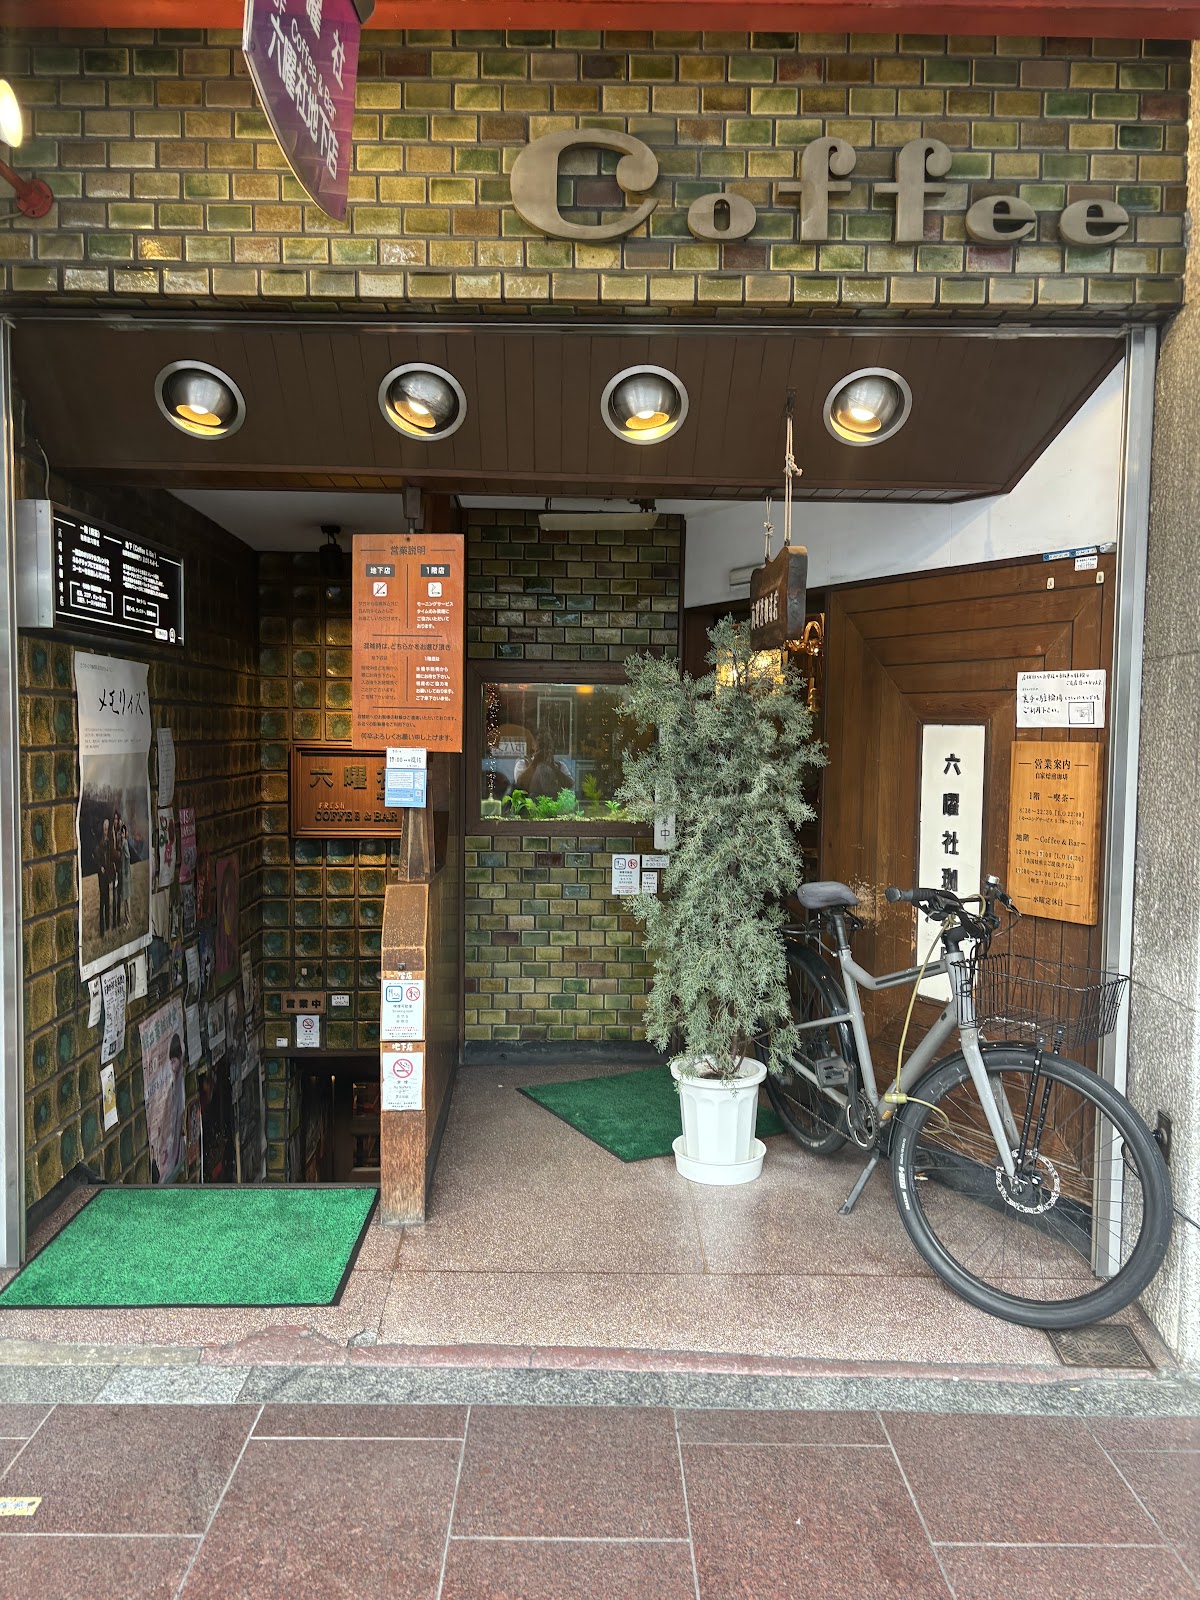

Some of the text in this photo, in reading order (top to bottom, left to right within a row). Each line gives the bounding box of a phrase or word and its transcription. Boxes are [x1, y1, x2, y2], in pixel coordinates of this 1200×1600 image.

[291, 18, 337, 121] Coffee & Bar
[268, 13, 339, 180] 六曜社地下店
[510, 128, 1131, 246] Coffee
[390, 545, 426, 556] 営業説明
[370, 566, 391, 575] 地下店
[426, 566, 445, 575] 1階店
[1034, 758, 1071, 770] 営業案内
[315, 811, 398, 823] COFFEE & BAR
[391, 1042, 414, 1052] 地下店
